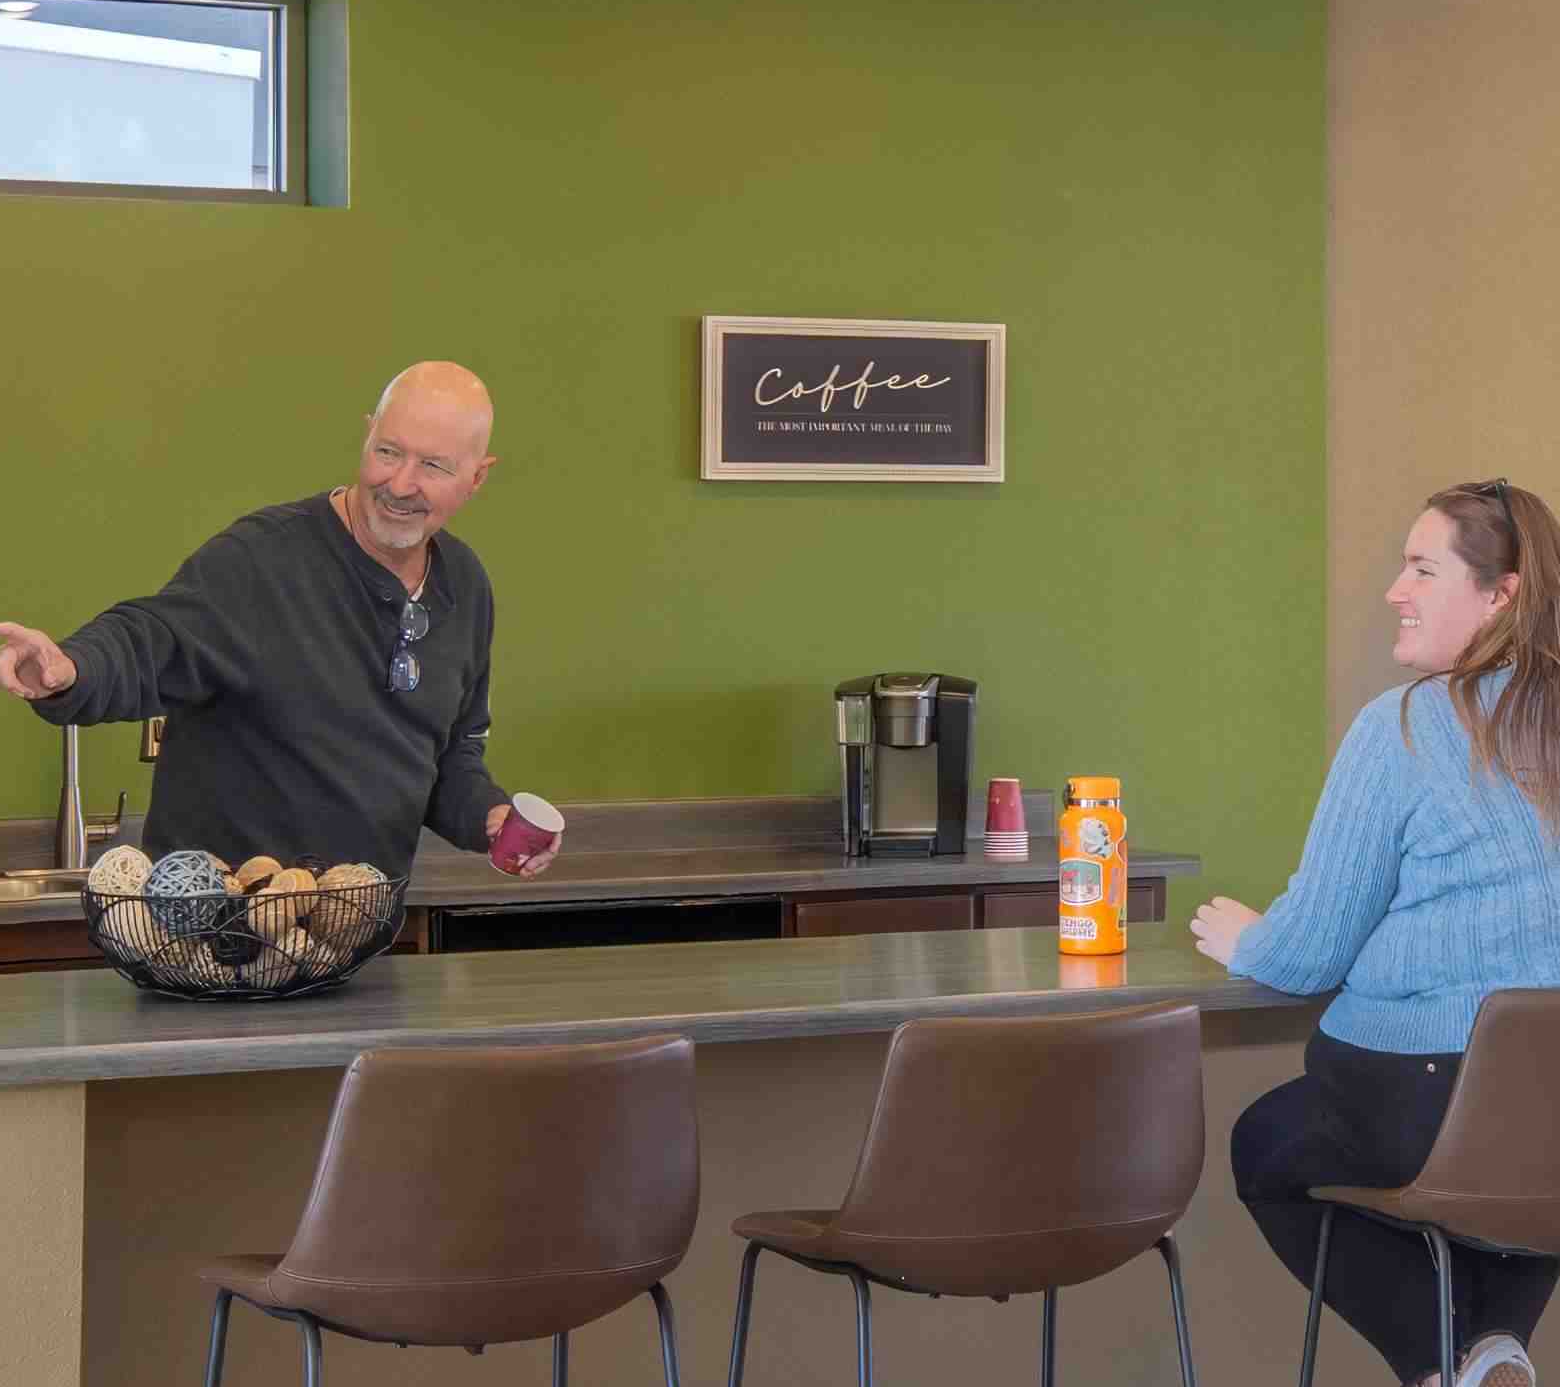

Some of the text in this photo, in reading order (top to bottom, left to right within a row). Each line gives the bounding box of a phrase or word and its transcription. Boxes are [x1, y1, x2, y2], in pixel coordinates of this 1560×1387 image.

[754, 361, 951, 413] Coffee
[779, 421, 806, 432] MOST
[913, 423, 934, 433] THE
